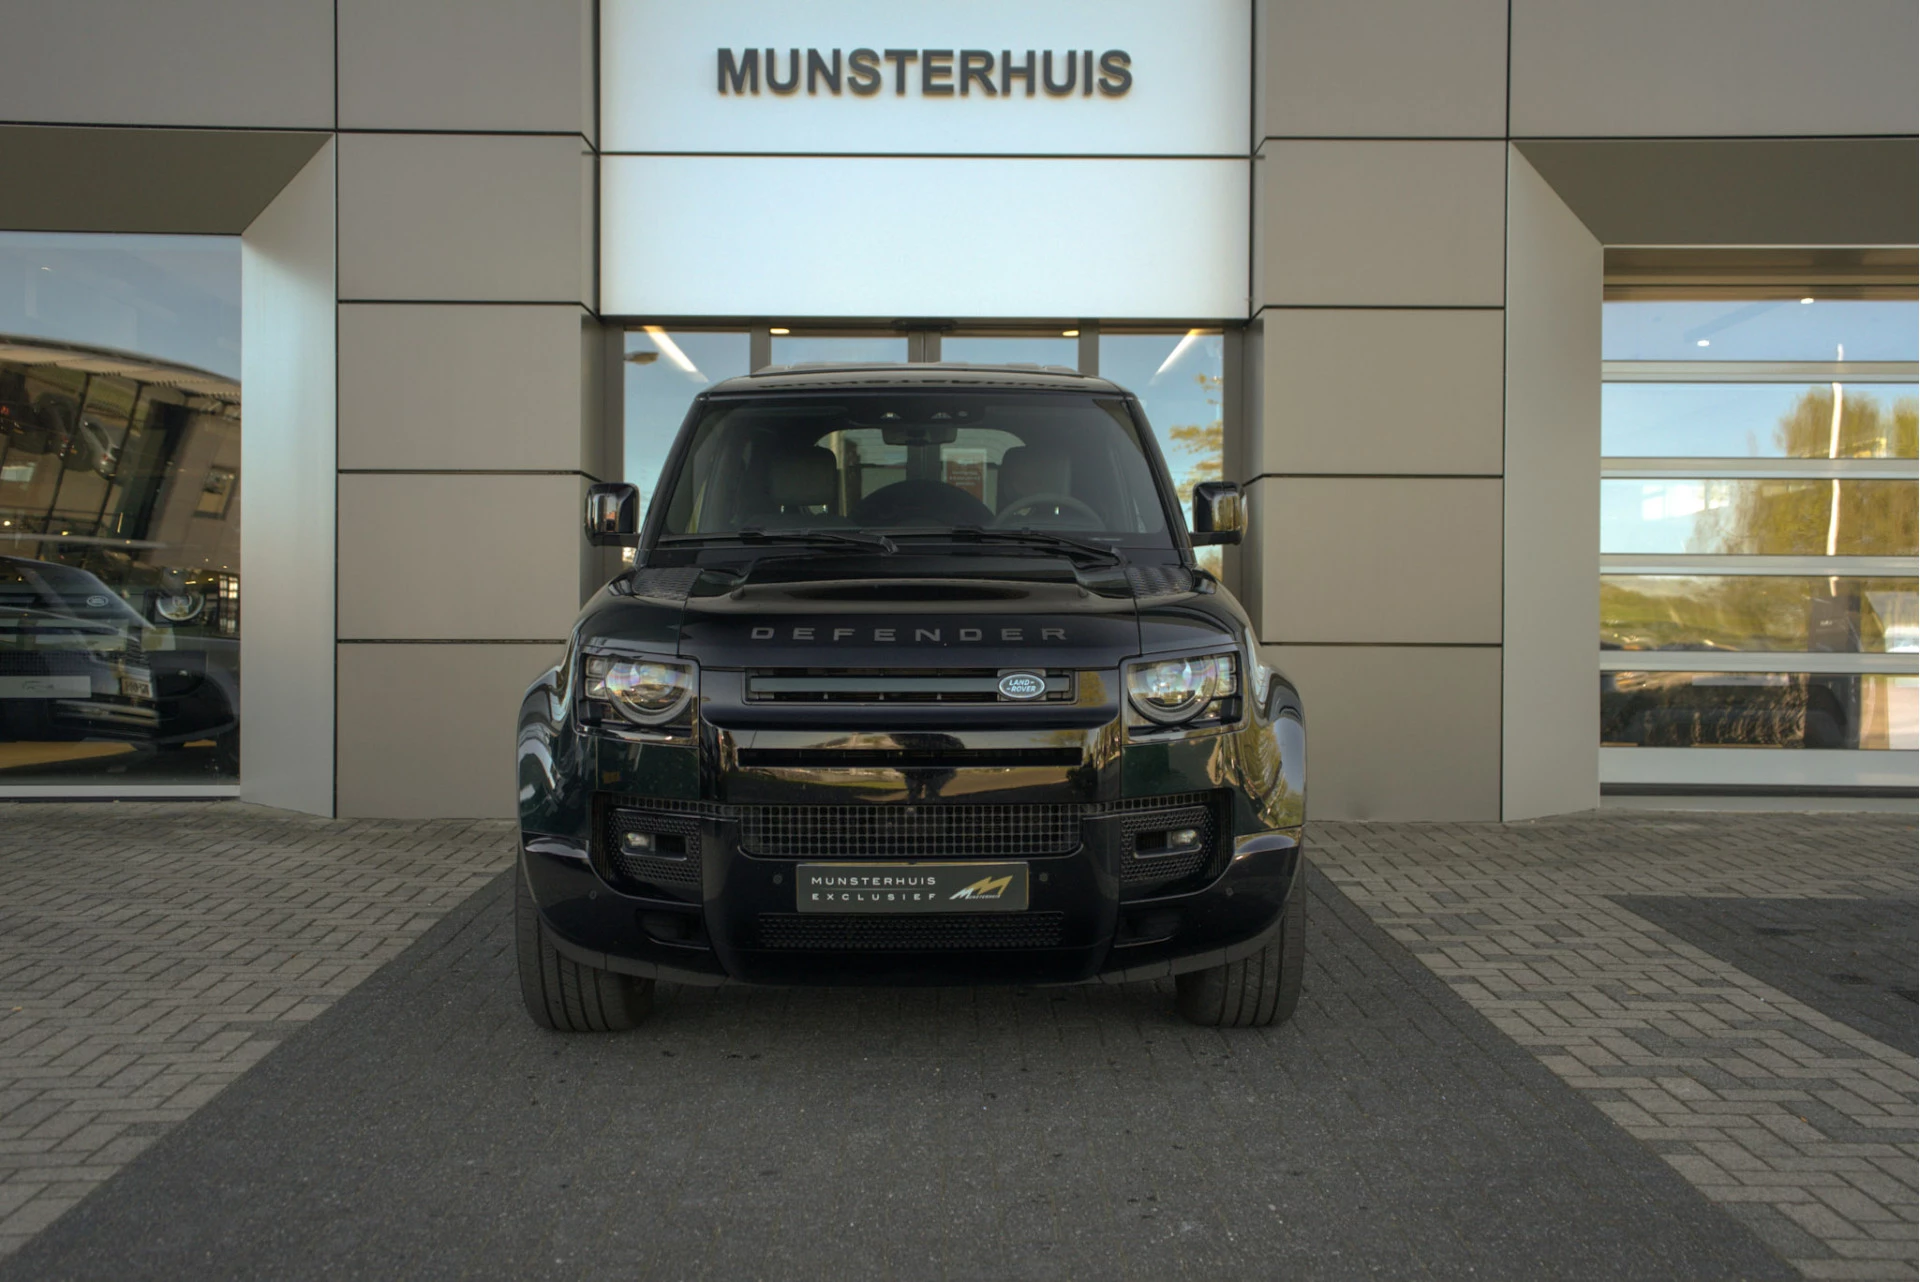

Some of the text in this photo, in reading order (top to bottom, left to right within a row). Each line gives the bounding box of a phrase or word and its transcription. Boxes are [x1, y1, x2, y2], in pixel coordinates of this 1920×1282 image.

[717, 48, 1133, 96] MUNSTERHUIS
[751, 627, 1067, 641] DEFENDER
[811, 877, 936, 886] MUNSTERHUIS
[811, 893, 936, 901] EXCLUSIEF
